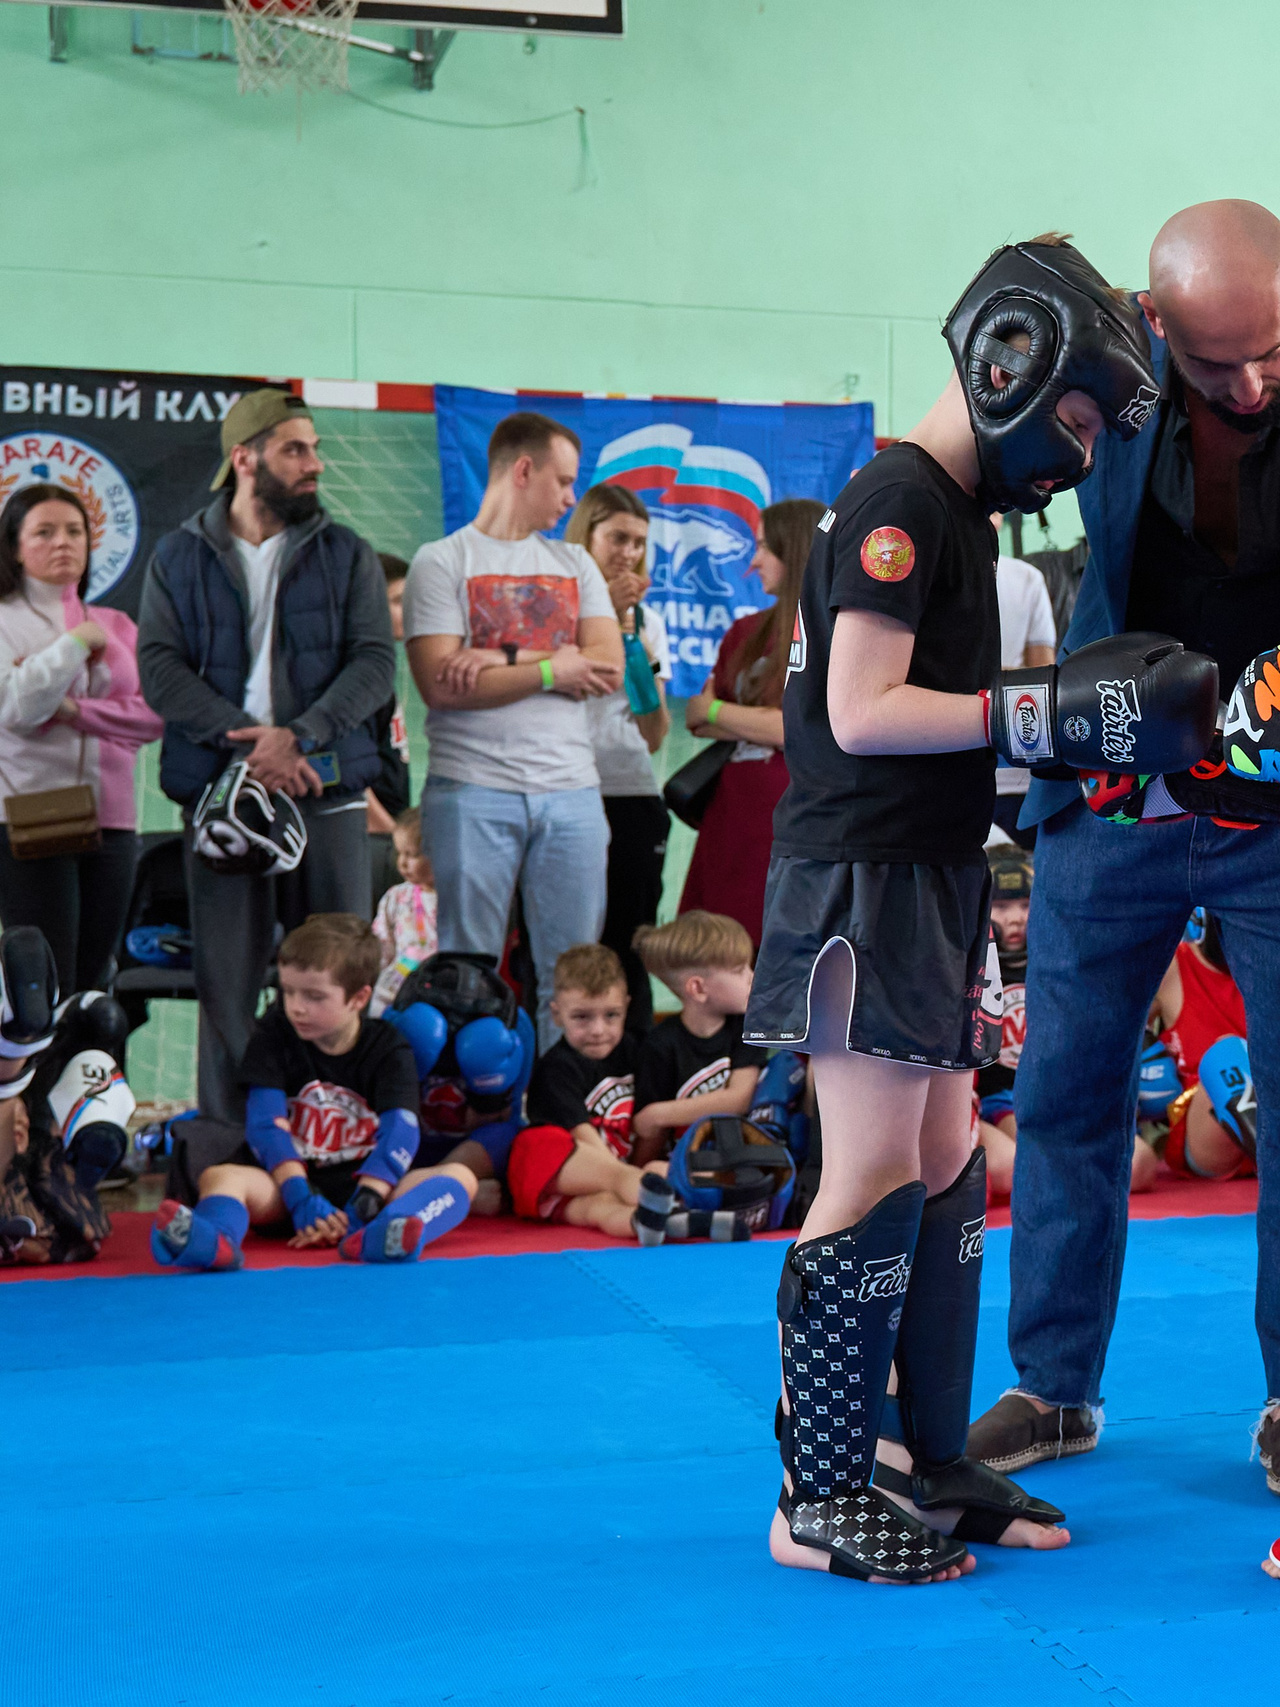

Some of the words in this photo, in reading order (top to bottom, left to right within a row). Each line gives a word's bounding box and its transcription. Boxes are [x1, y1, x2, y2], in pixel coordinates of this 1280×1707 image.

[3, 380, 141, 421] ВНЫЙ
[155, 389, 240, 422] КЛУ
[0, 438, 102, 479] ARATE
[1019, 705, 1036, 744] Fairtex
[1096, 679, 1142, 763] Fairtex
[416, 1191, 456, 1225] INSA
